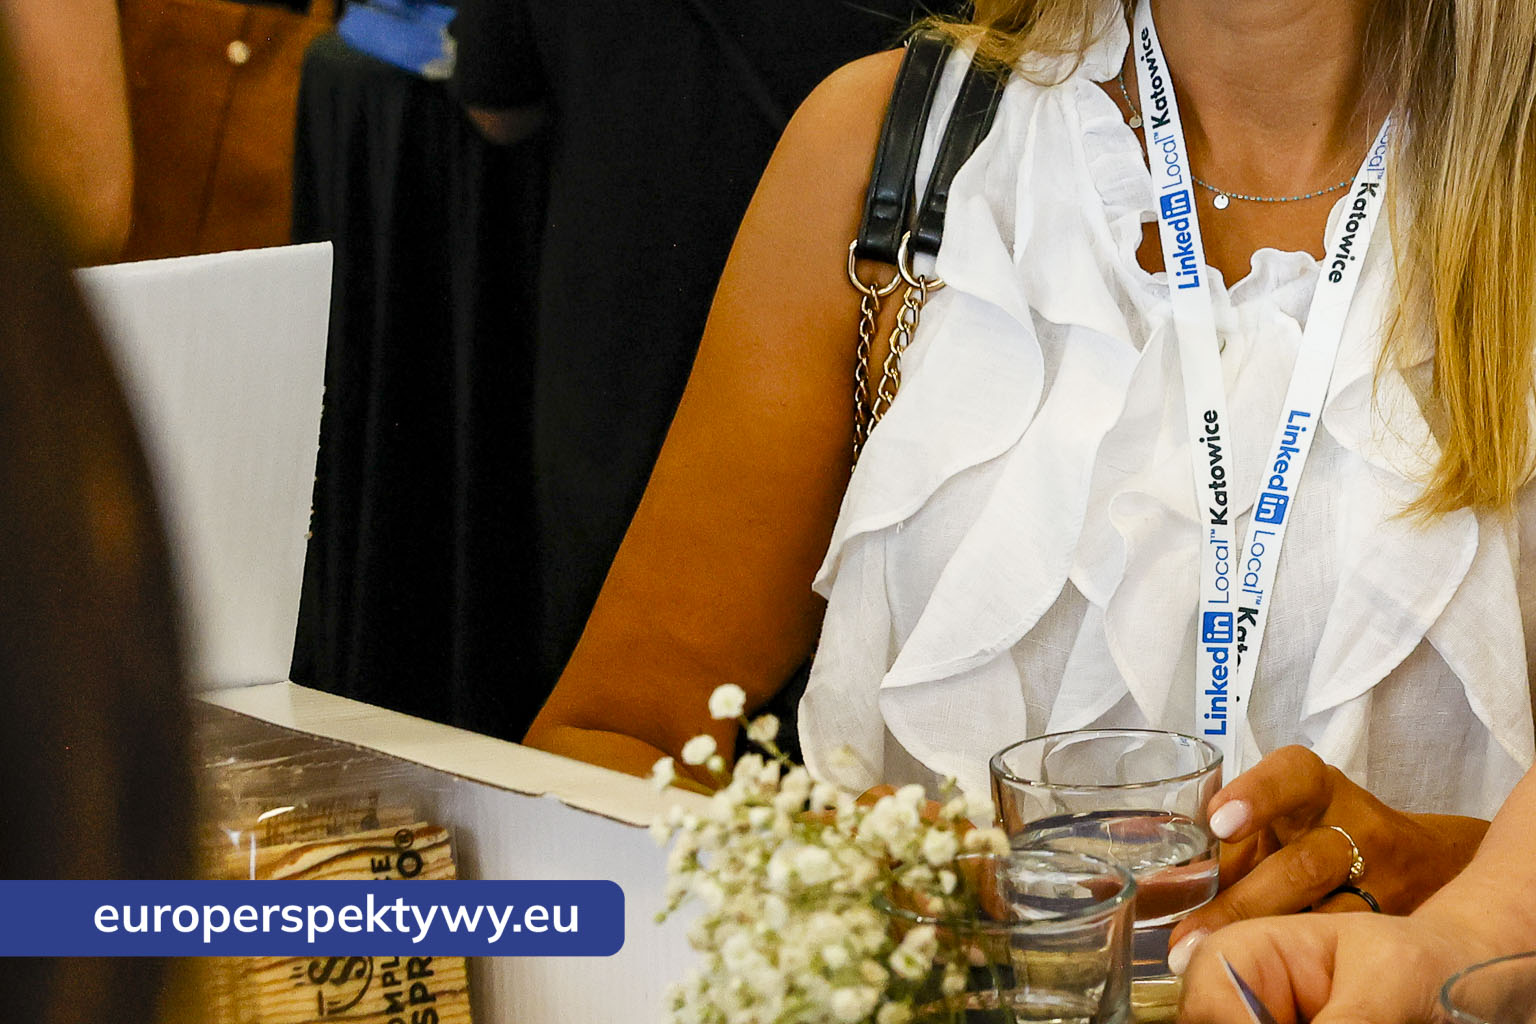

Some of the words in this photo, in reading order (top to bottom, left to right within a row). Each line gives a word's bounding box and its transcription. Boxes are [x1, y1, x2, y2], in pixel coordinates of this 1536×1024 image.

[1141, 28, 1171, 130] Katowice
[1329, 181, 1379, 284] Katowice
[1199, 409, 1228, 525] Katowice
